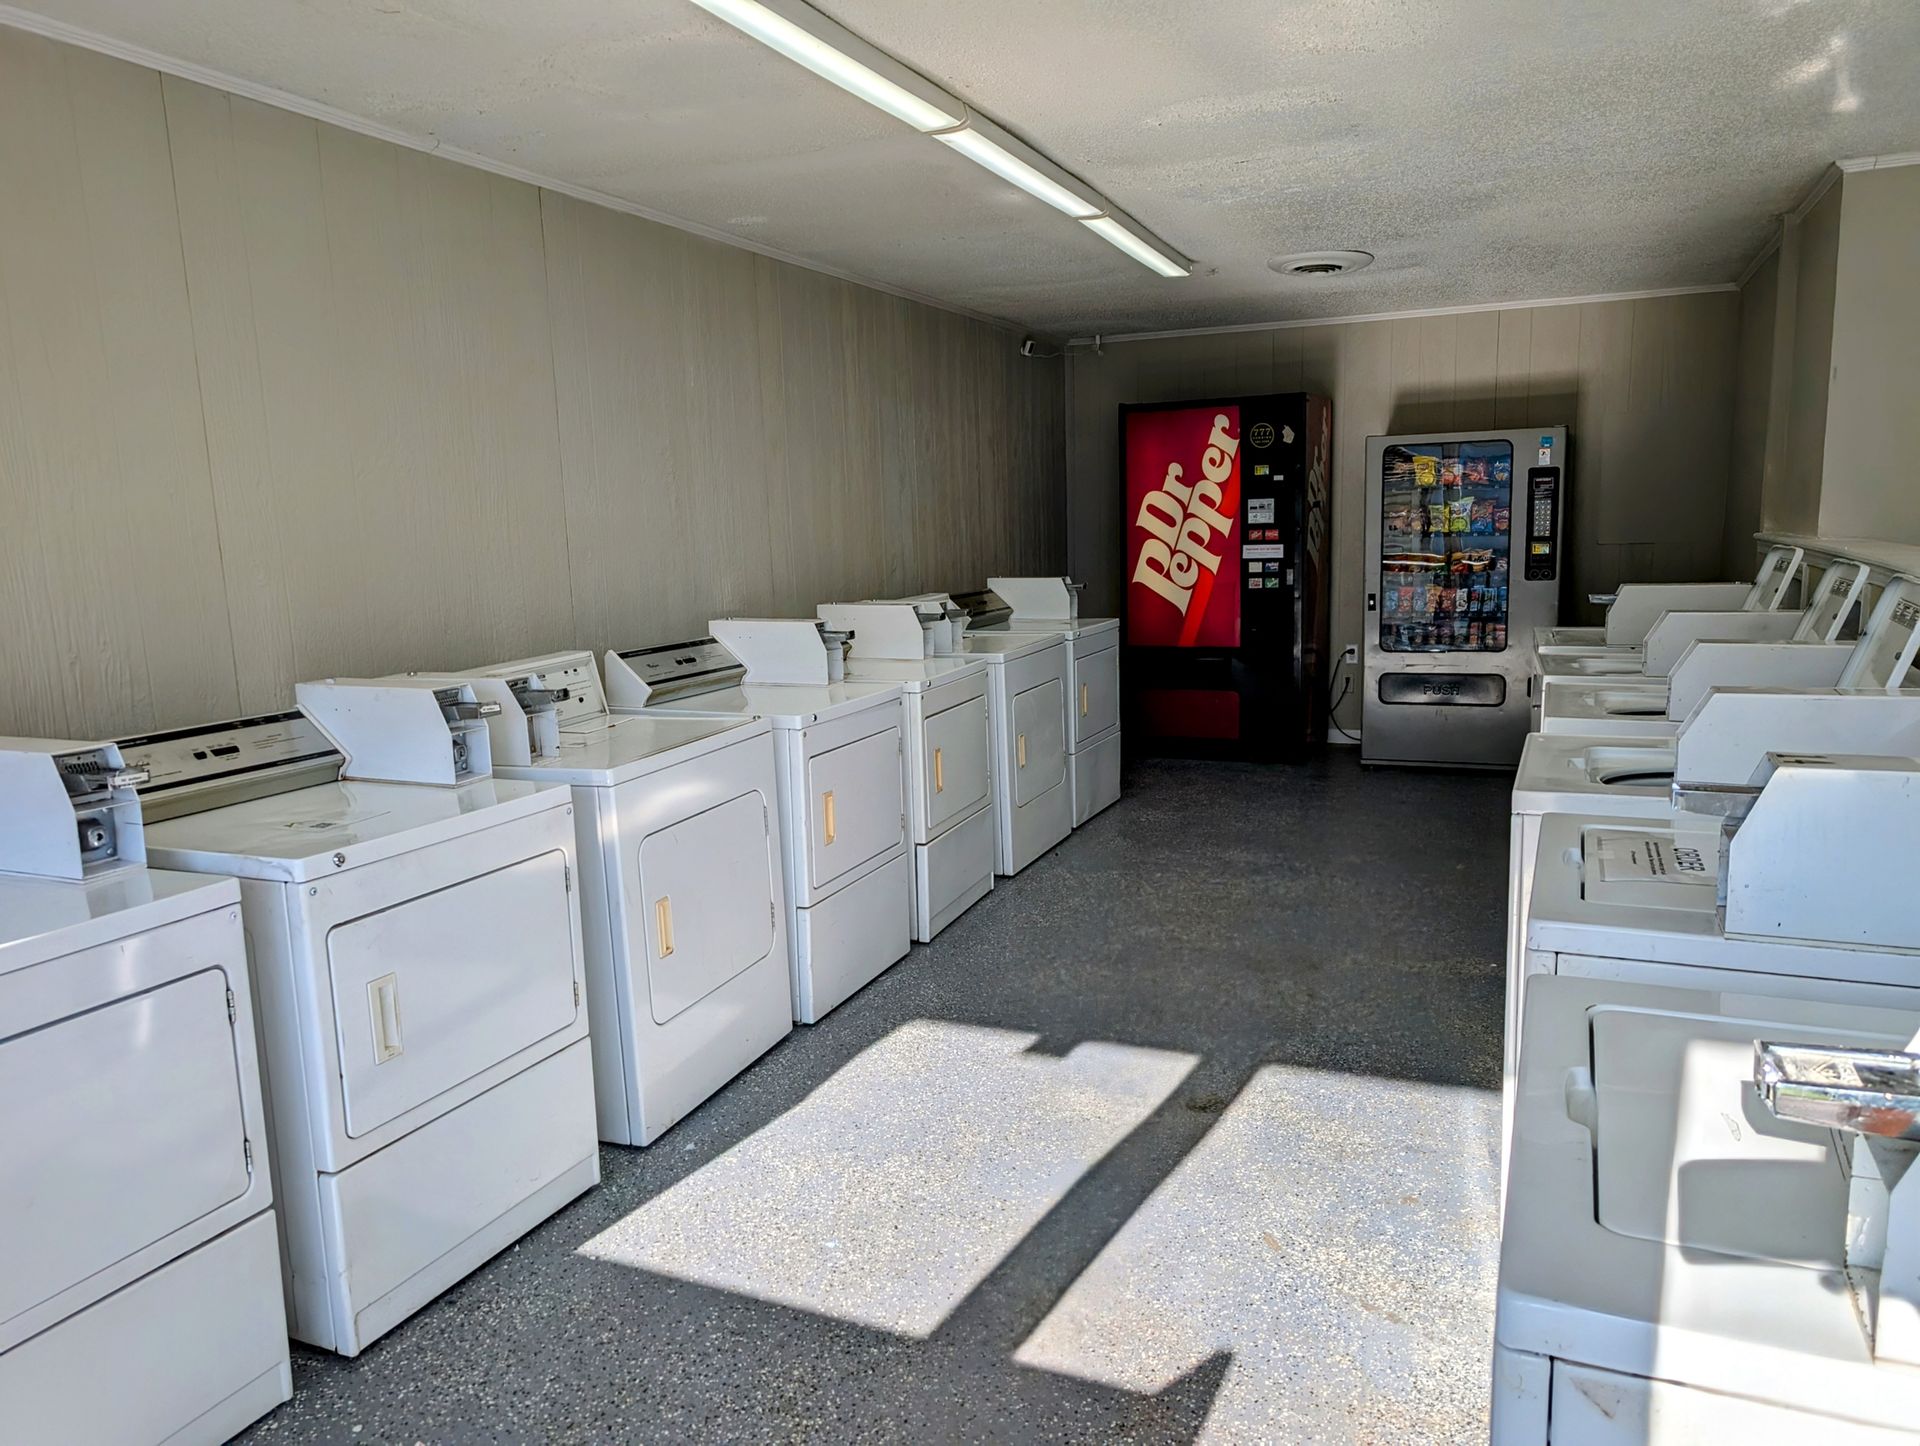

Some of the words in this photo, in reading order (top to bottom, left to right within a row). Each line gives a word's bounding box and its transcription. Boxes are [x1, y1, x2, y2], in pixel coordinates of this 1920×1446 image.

[1253, 428, 1271, 436] 777
[1132, 414, 1240, 617] Pepper
[1136, 462, 1193, 550] Dr
[1423, 684, 1460, 695] PUSH
[1673, 847, 1706, 871] ORDER
